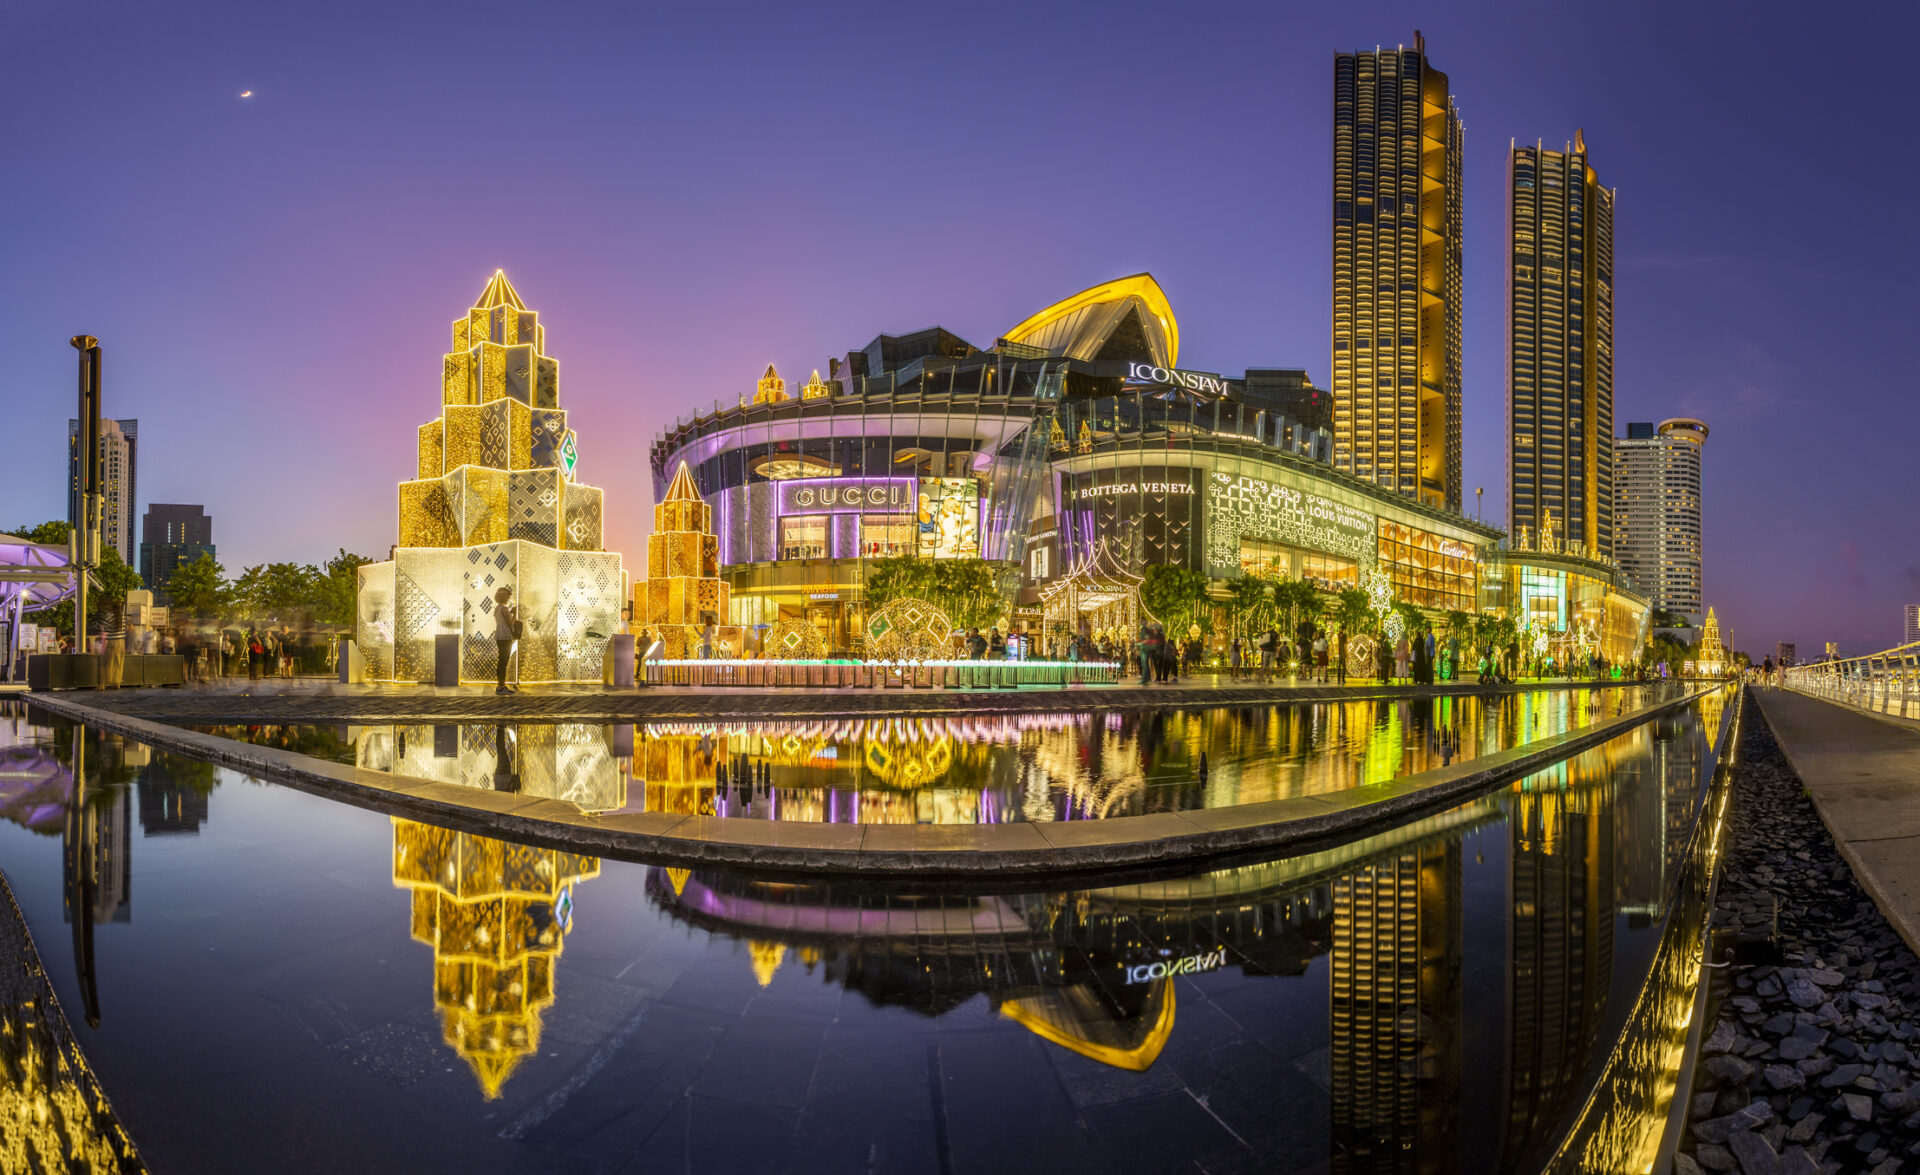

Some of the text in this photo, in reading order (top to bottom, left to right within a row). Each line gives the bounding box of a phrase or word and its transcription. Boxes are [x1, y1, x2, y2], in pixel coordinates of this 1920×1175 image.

[1128, 361, 1229, 396] ICONSIAM
[795, 486, 899, 506] GUCCI
[1081, 482, 1196, 499] BOTTEGA VENETA
[1309, 505, 1368, 532] LOUIS VUITTON
[1439, 540, 1468, 561] Cartier
